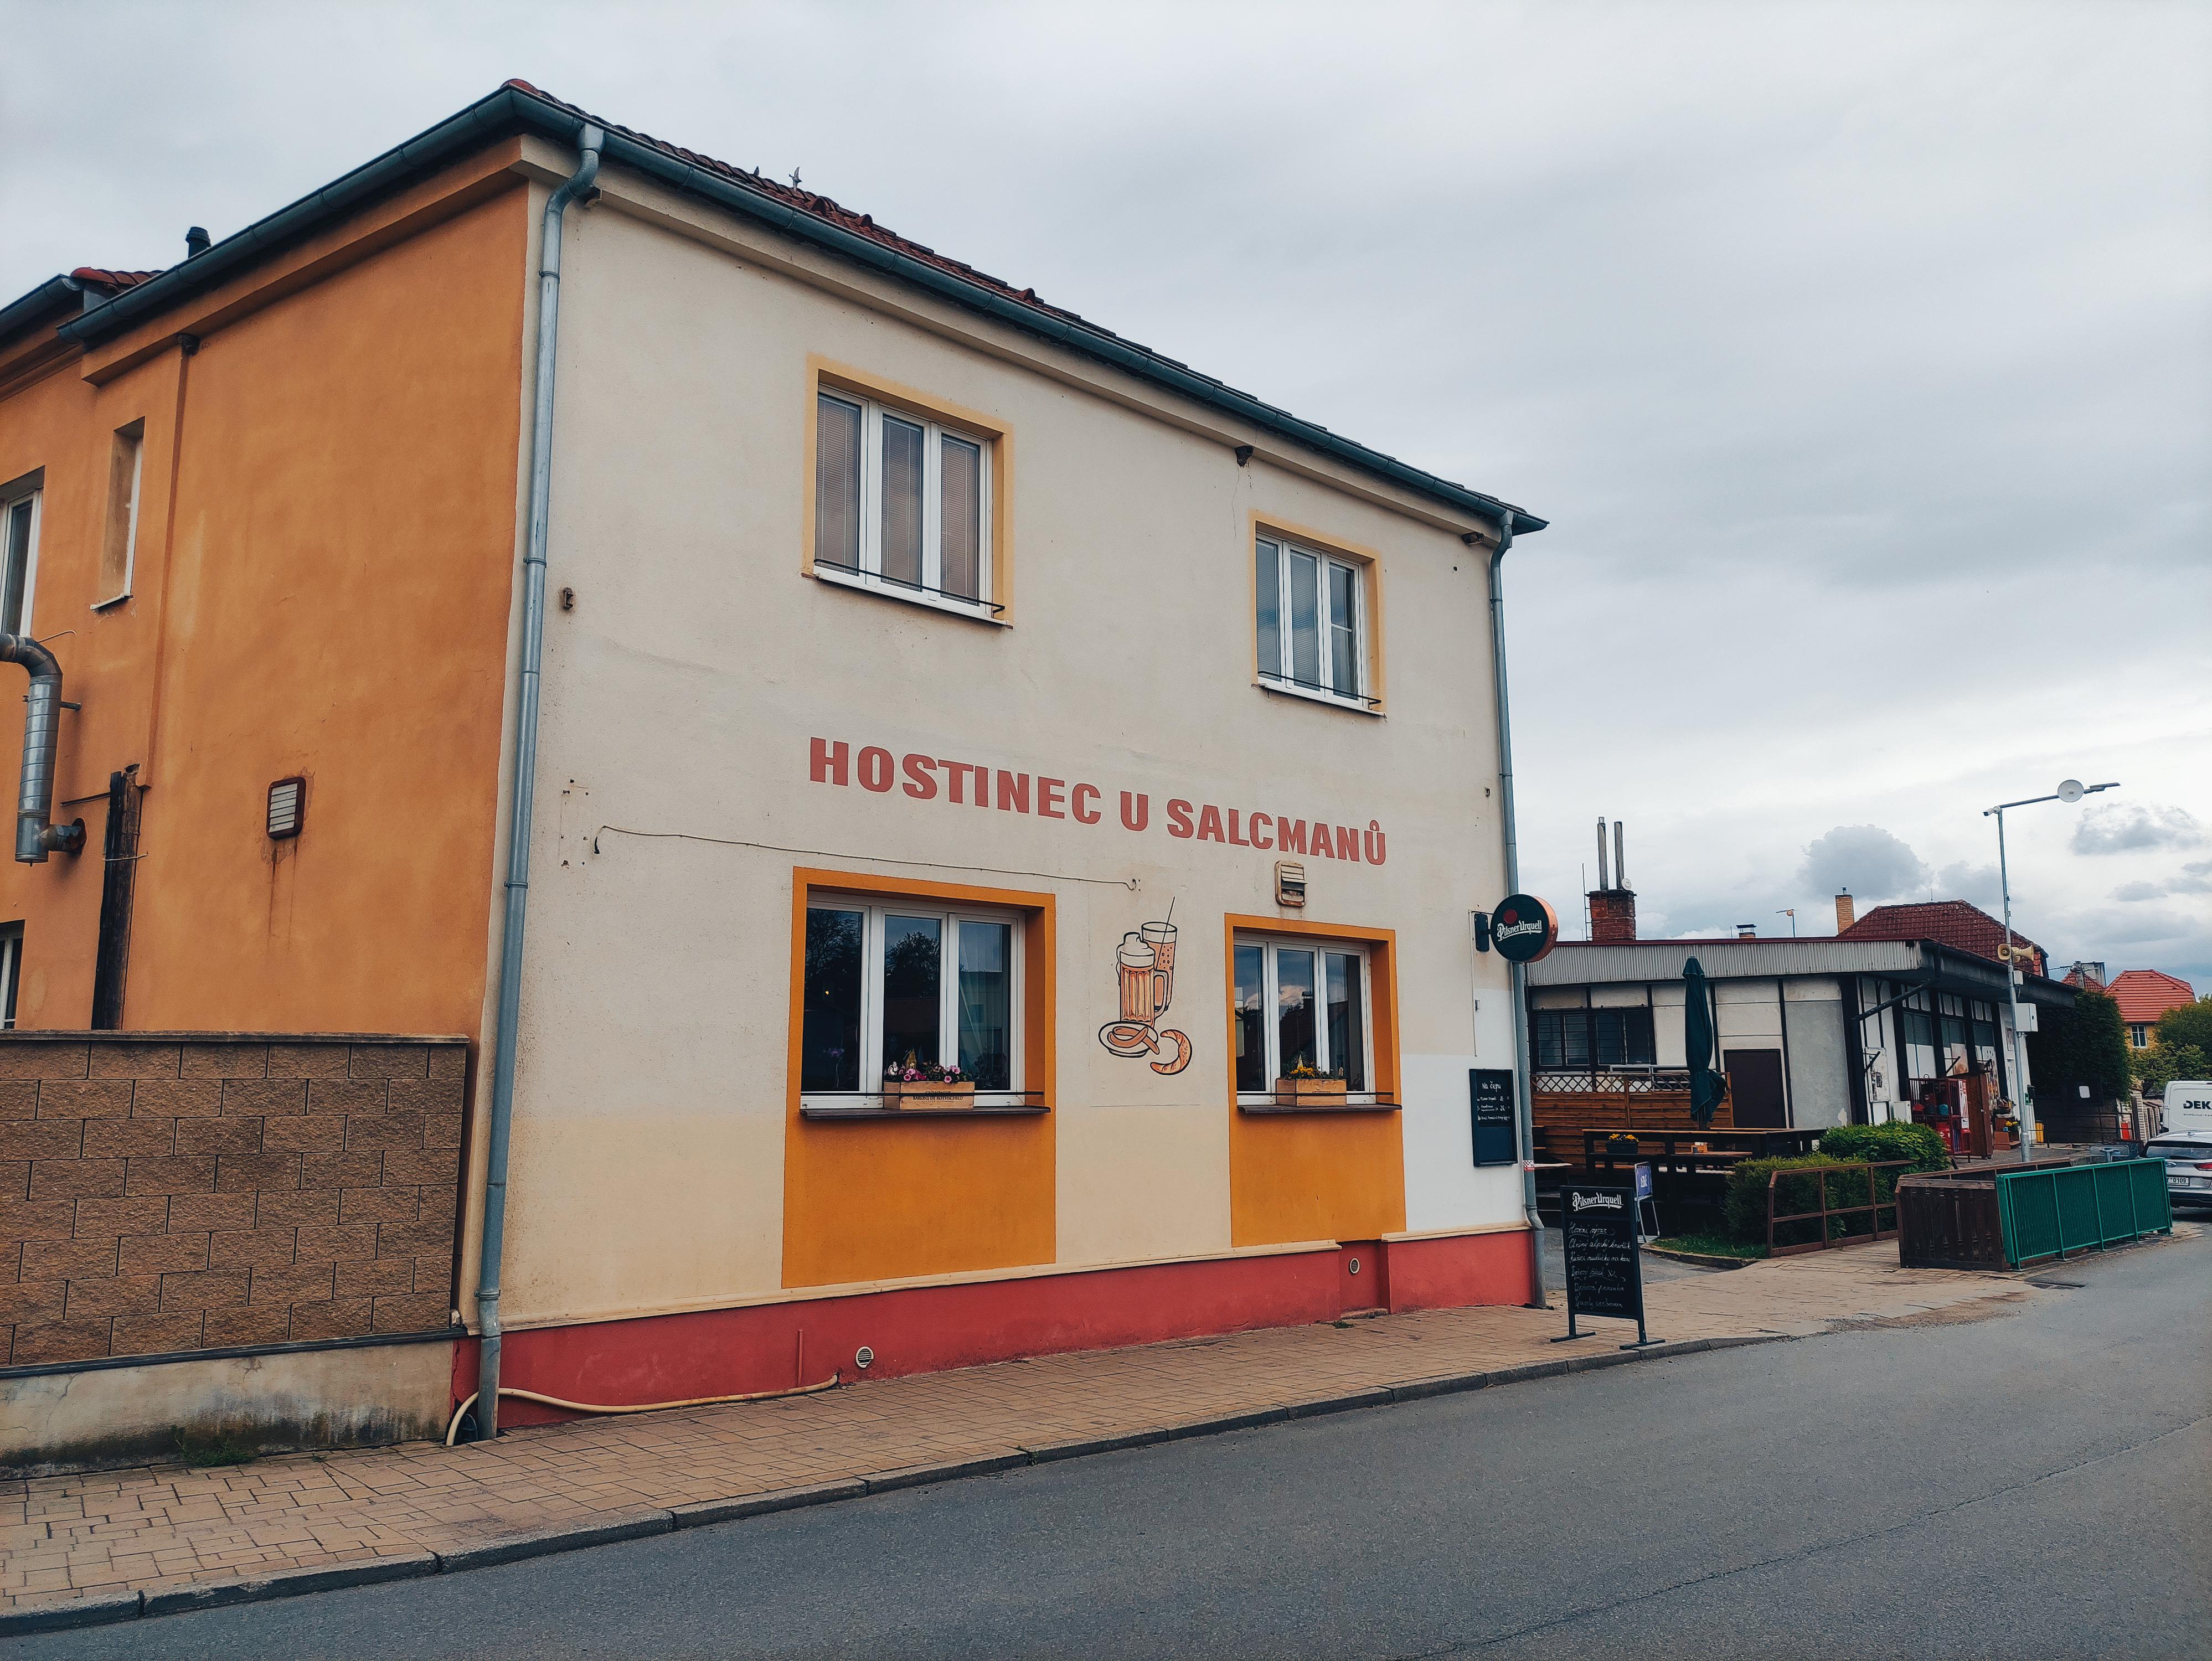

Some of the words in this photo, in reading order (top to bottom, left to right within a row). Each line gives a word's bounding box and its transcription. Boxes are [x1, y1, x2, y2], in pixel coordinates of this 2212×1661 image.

[810, 737, 1101, 824] HOSTINEC
[1121, 791, 1148, 832] U
[1167, 799, 1386, 865] SALCMANŮ
[1497, 923, 1519, 941] Pilsner
[1519, 920, 1543, 935] Urquell
[1490, 1081, 1501, 1092] čepu
[1572, 1192, 1597, 1211] Pilsner
[1596, 1192, 1623, 1208] Urquell
